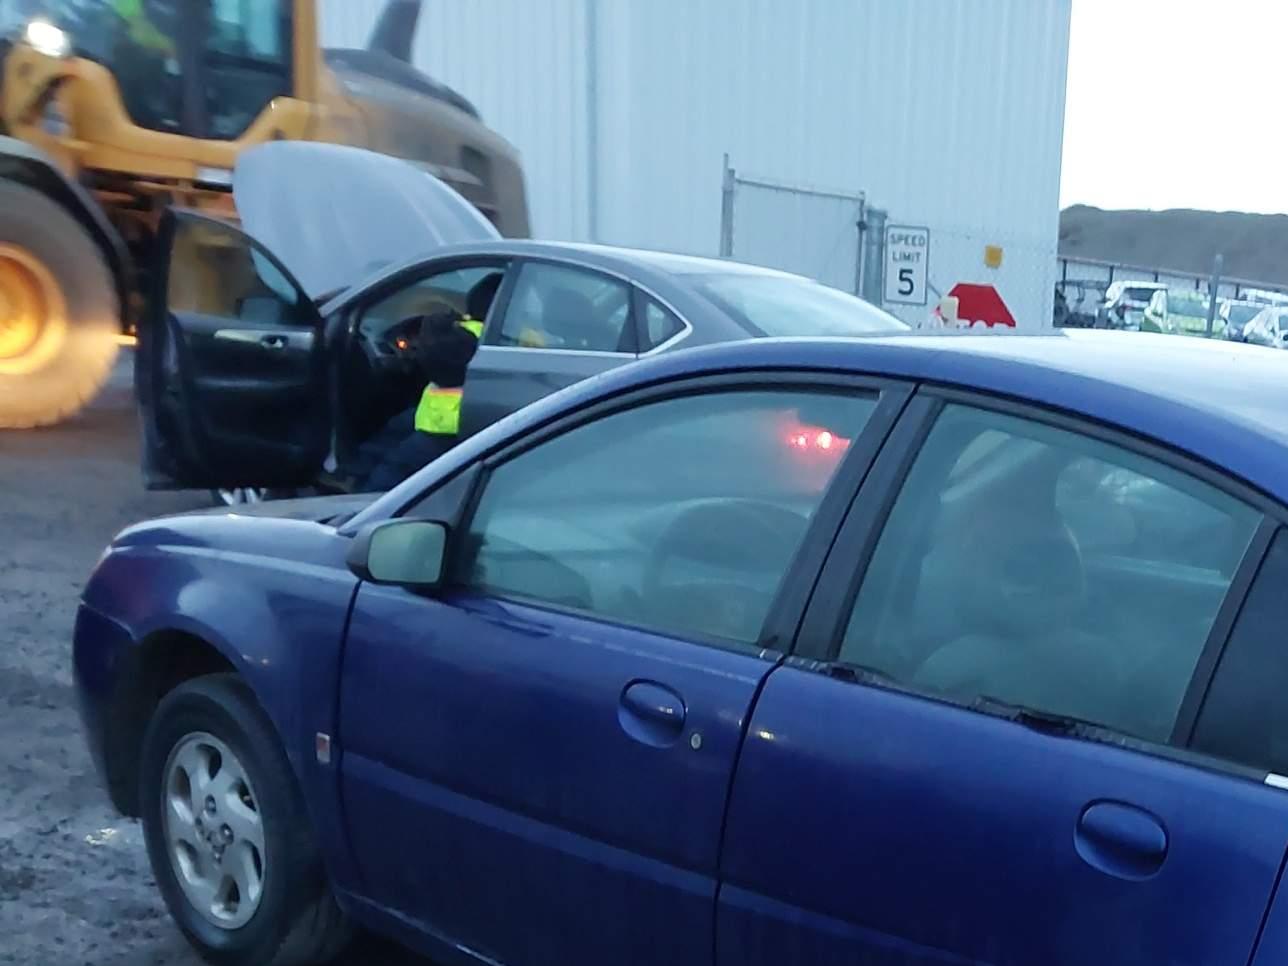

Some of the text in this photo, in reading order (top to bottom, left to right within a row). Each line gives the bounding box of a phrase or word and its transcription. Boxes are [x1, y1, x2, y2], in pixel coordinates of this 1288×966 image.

[890, 233, 926, 247] SPEED
[892, 252, 922, 263] LIMIT
[897, 268, 915, 296] 5
